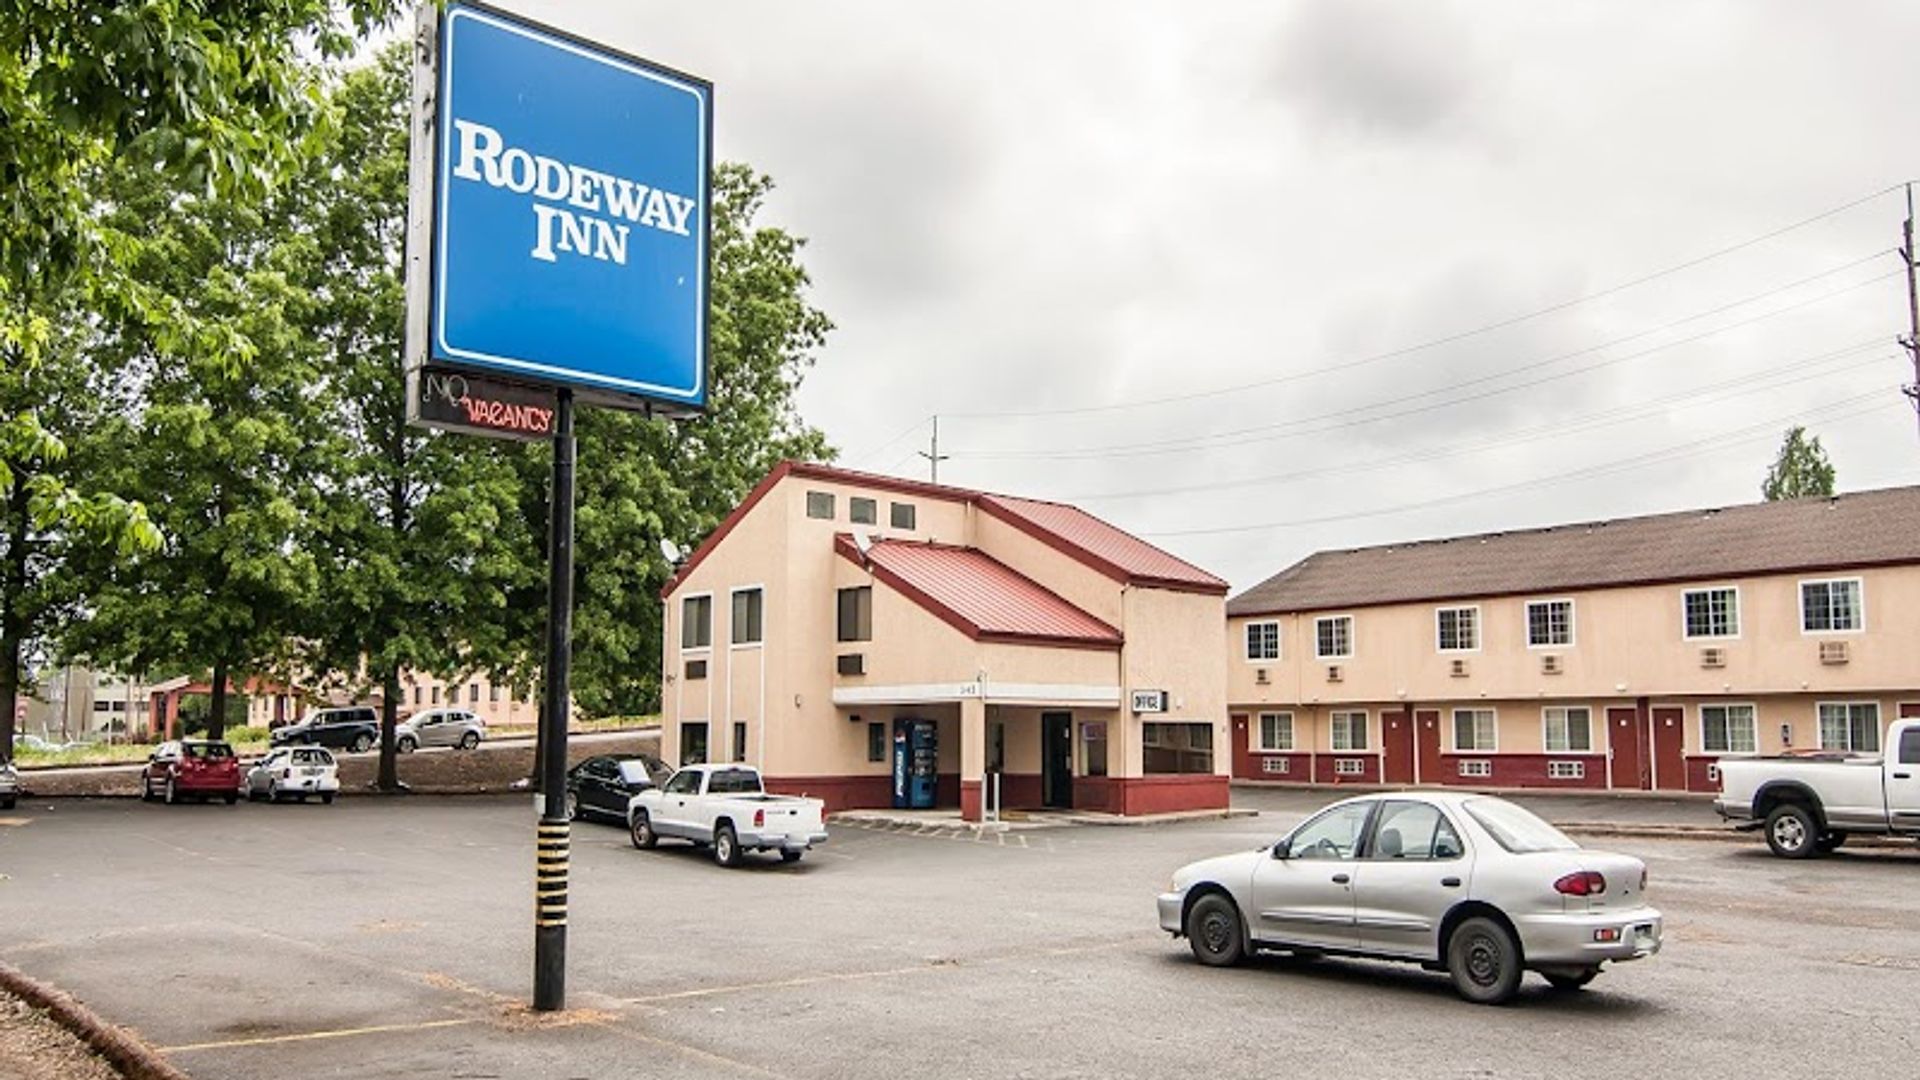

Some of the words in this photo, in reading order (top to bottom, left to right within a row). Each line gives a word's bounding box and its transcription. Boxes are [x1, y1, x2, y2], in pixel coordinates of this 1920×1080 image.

[454, 119, 695, 236] RODEWAY
[532, 203, 630, 264] INN
[422, 374, 468, 407] NO
[461, 396, 553, 432] VACANCY
